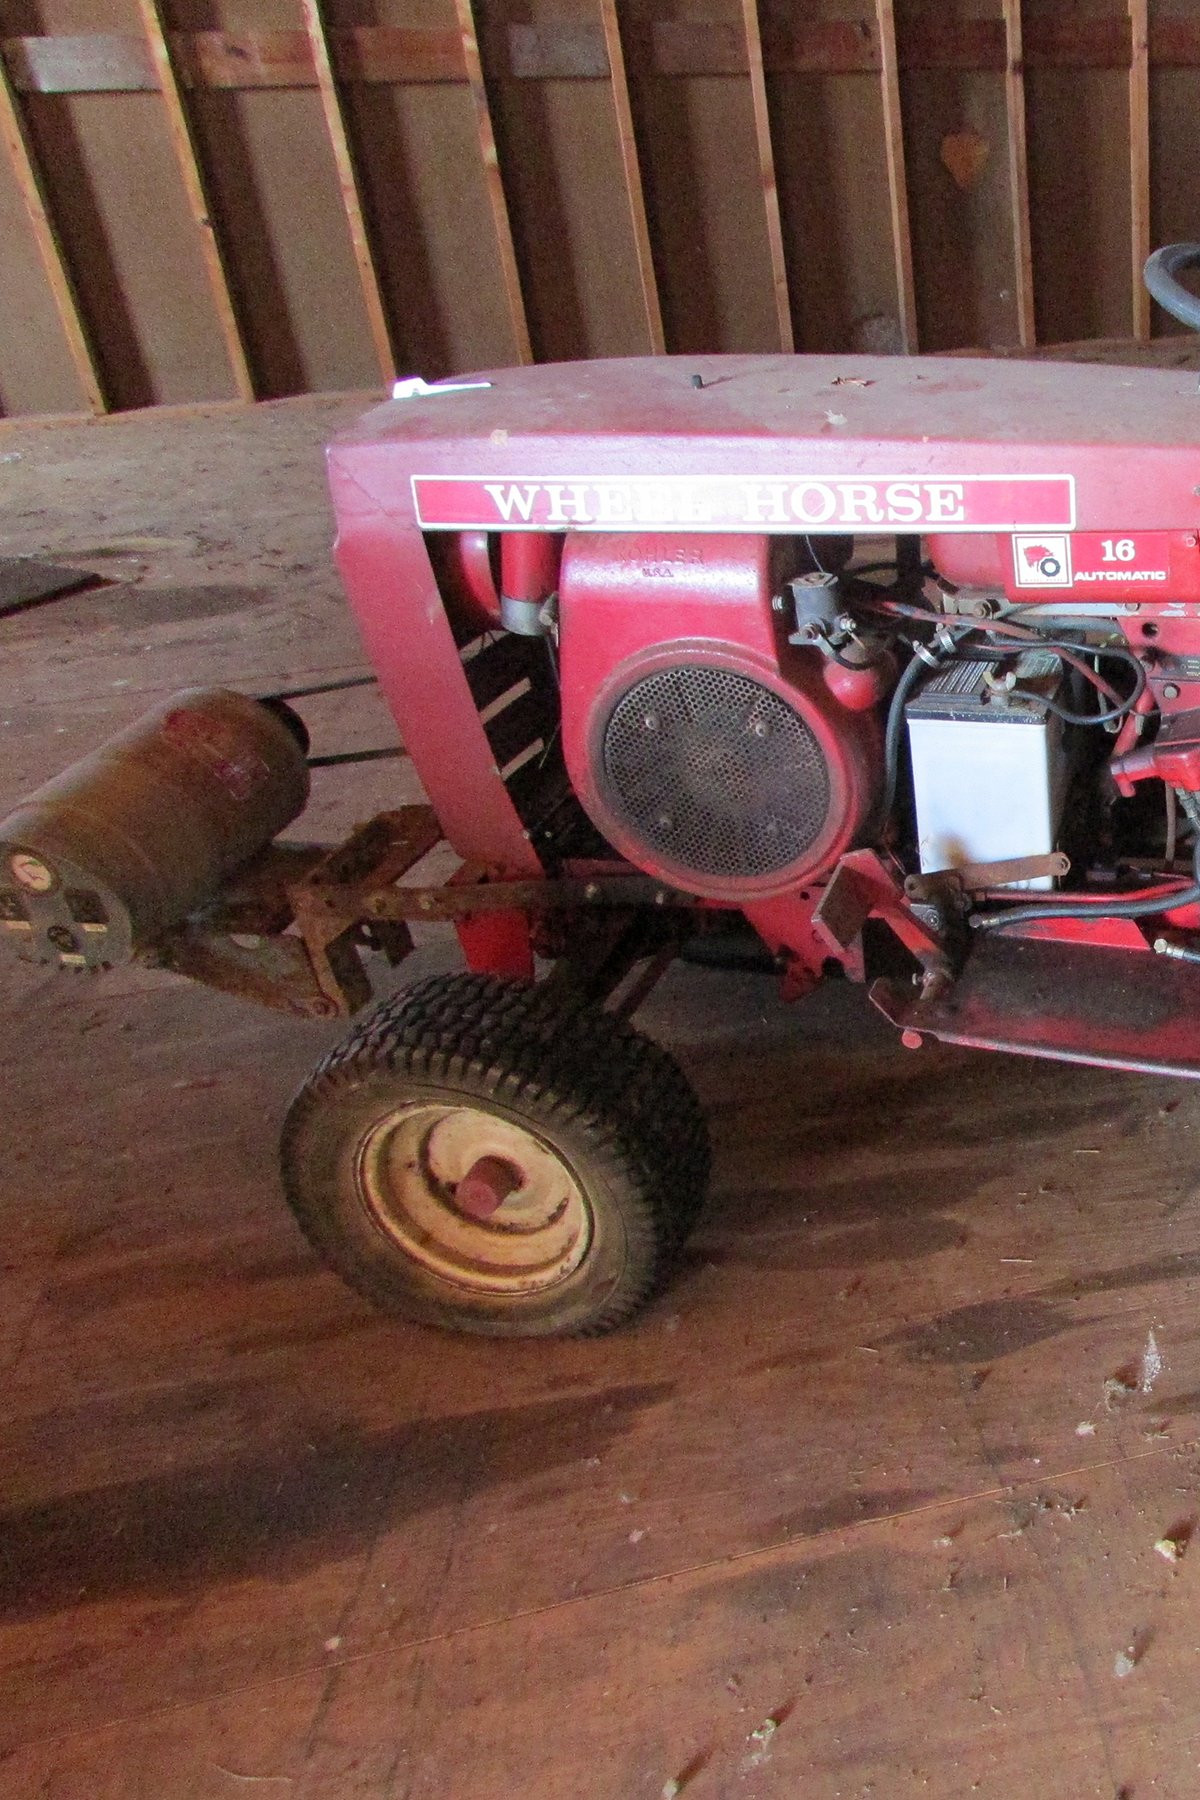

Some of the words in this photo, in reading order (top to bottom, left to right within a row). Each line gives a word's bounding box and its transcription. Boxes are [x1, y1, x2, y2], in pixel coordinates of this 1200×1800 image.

[484, 484, 712, 523] WHEEL
[742, 482, 965, 523] HORSE
[618, 547, 704, 565] KOHLER
[1100, 539, 1136, 562] 16
[1073, 570, 1166, 581] AUTOMATIC
